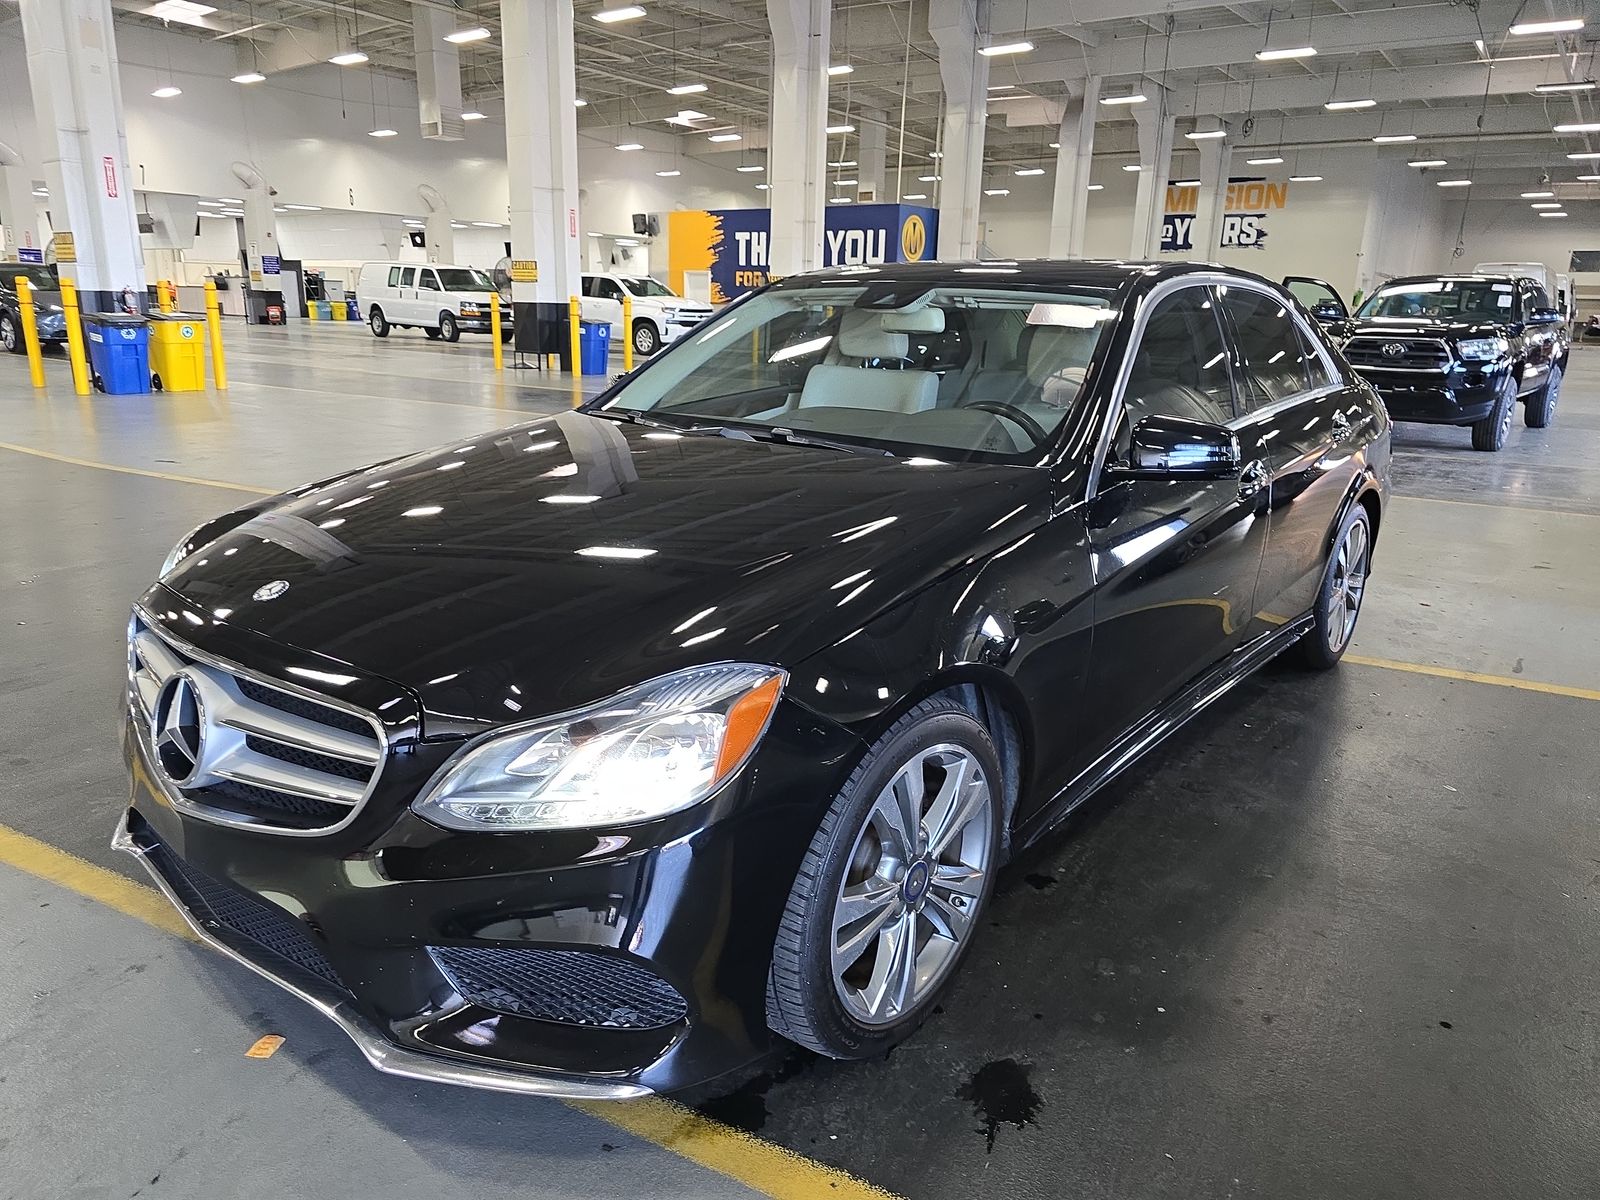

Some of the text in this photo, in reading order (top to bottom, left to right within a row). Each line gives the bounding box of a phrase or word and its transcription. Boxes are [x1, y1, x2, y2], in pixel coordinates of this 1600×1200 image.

[348, 187, 354, 206] 6
[1165, 182, 1287, 213] MISION
[1174, 216, 1259, 246] YRS
[735, 229, 887, 266] TH YOU
[735, 271, 765, 287] FOR
